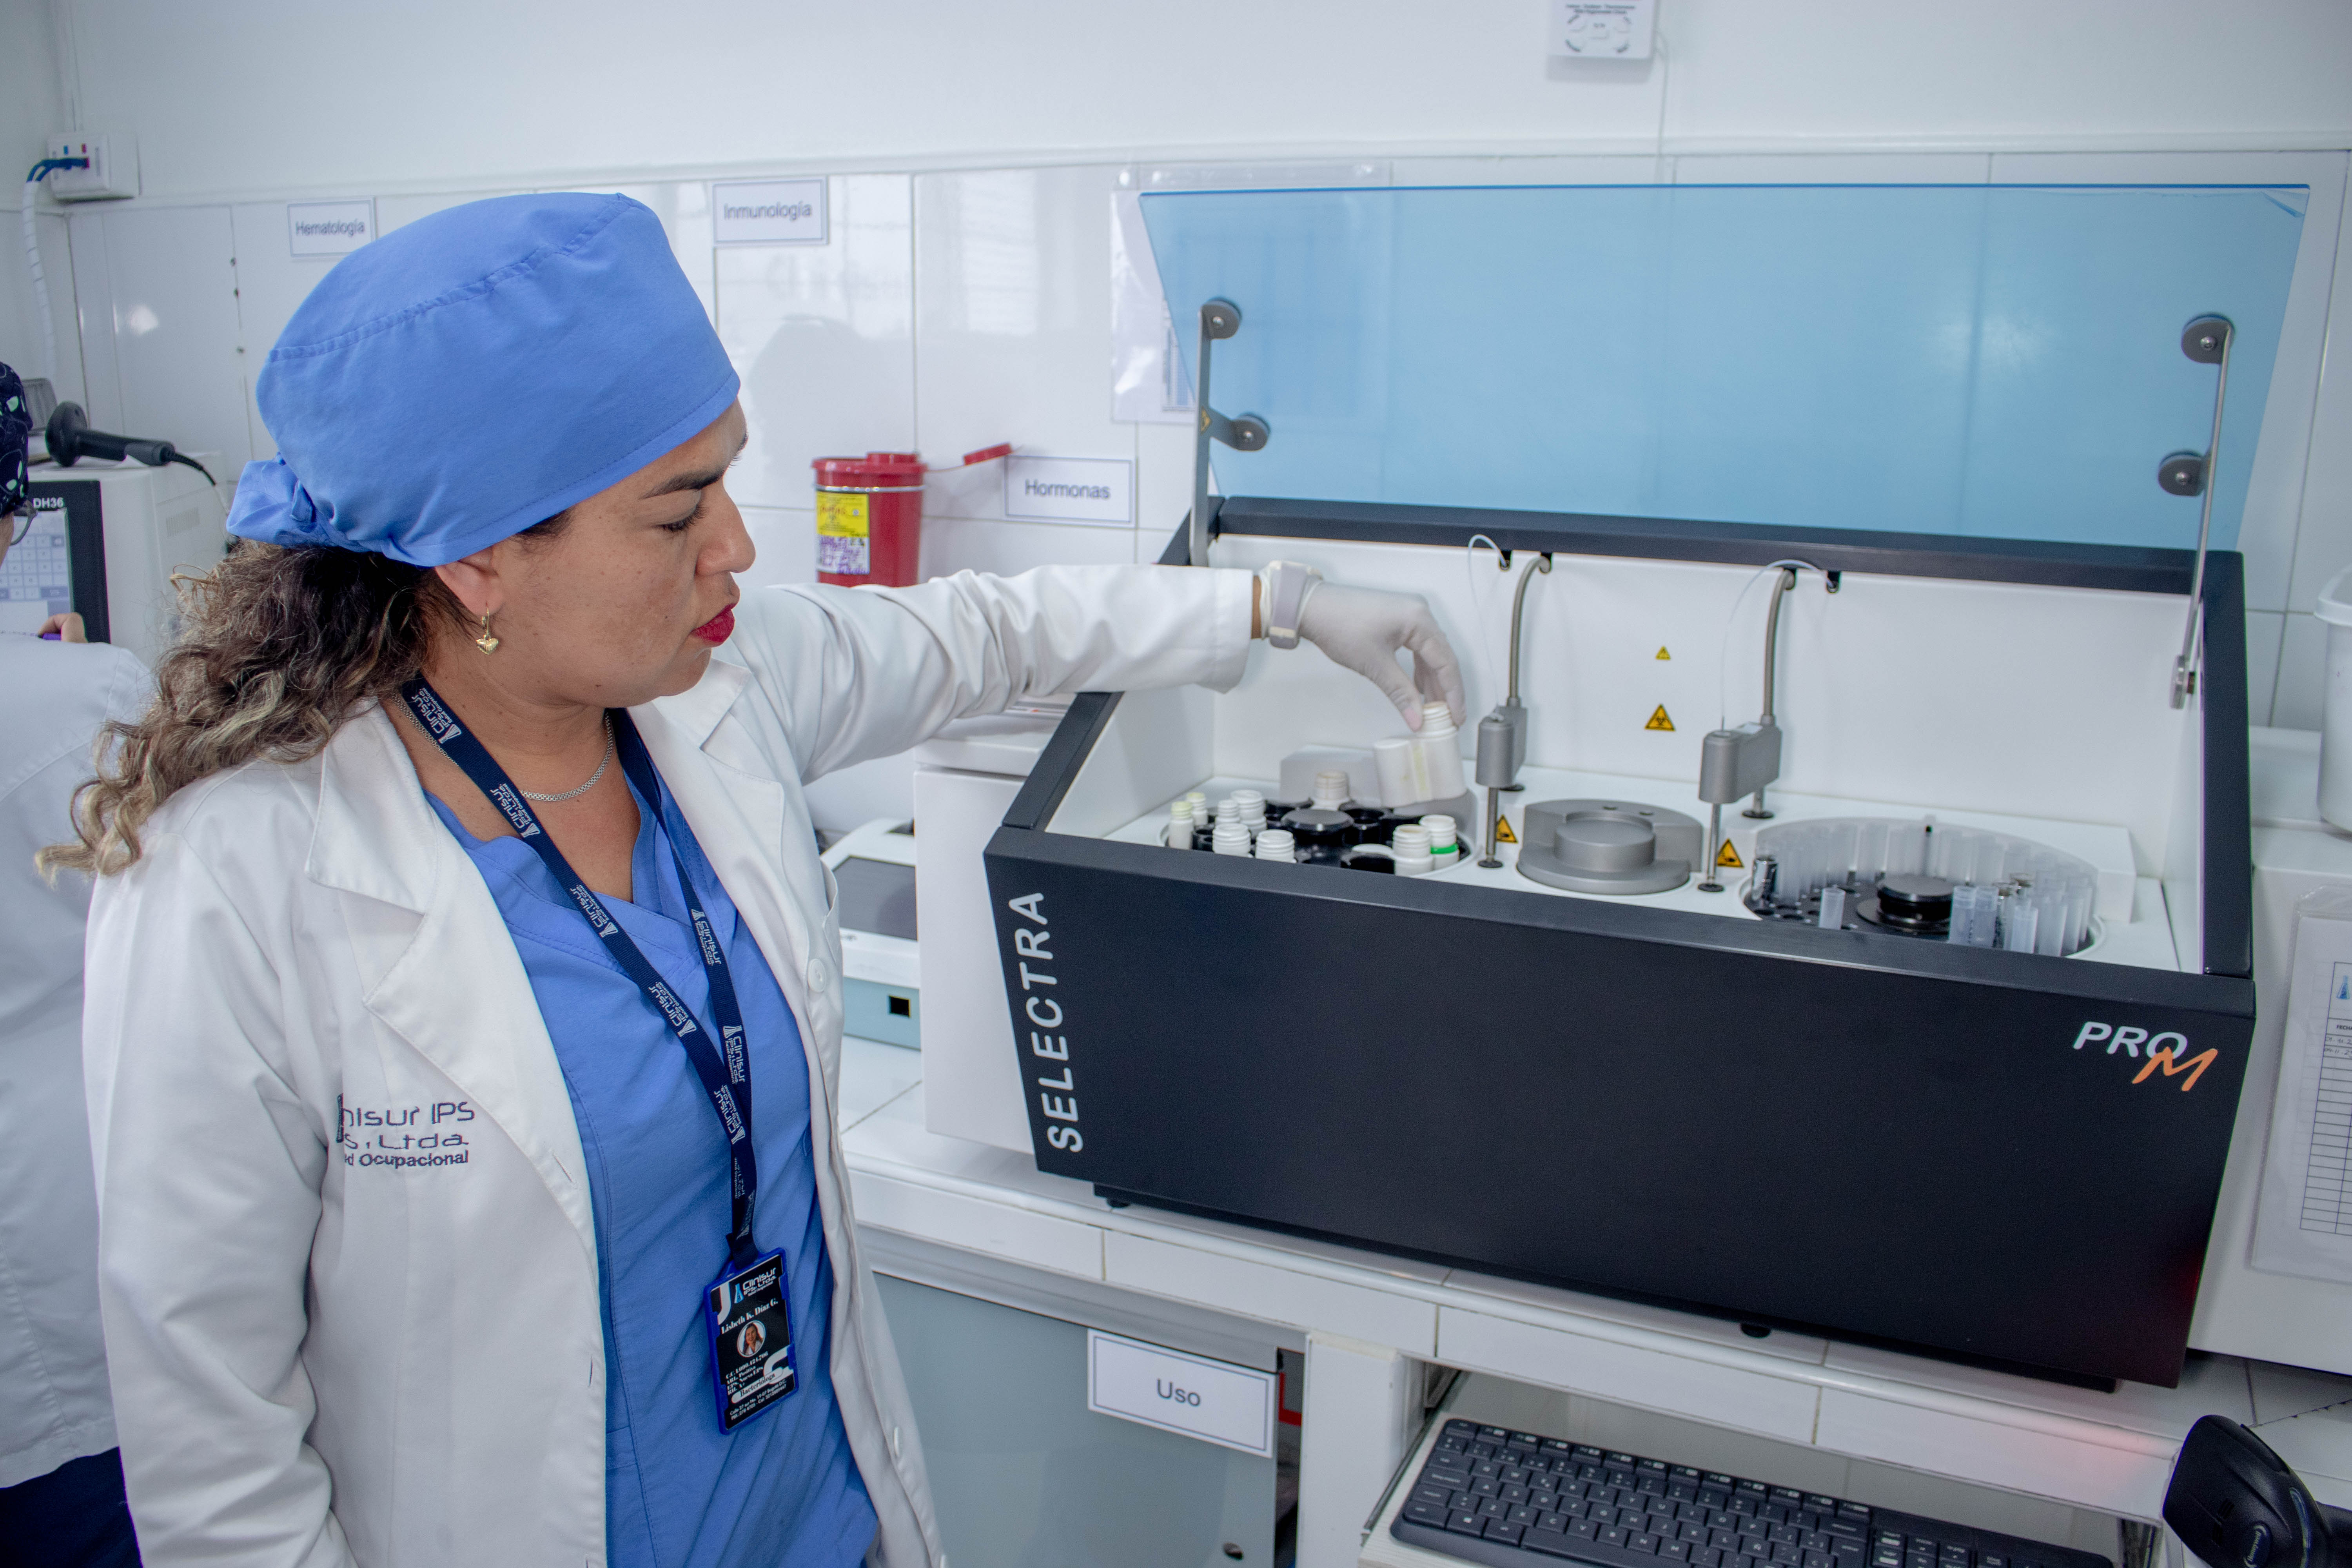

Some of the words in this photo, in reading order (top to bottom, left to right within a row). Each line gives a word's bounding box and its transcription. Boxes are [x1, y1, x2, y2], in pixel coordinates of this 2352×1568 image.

[296, 218, 366, 238] Hematología
[724, 201, 813, 222] Inmunología
[1025, 478, 1111, 500] Hormonas
[412, 695, 445, 733] Clinisur
[490, 789, 525, 828] Clinisur
[570, 887, 603, 927] Clinisur
[701, 921, 721, 964] Clinisur
[648, 986, 682, 1026] Clinisur
[1008, 893, 1083, 1152] SELECTRA
[732, 1036, 745, 1082] Clinisur
[2073, 1021, 2188, 1059] PRO
[432, 1101, 476, 1124] IPS
[714, 1091, 736, 1133] Clinisur
[358, 1149, 468, 1169] Ocupacional
[1157, 1378, 1201, 1407] Uso
